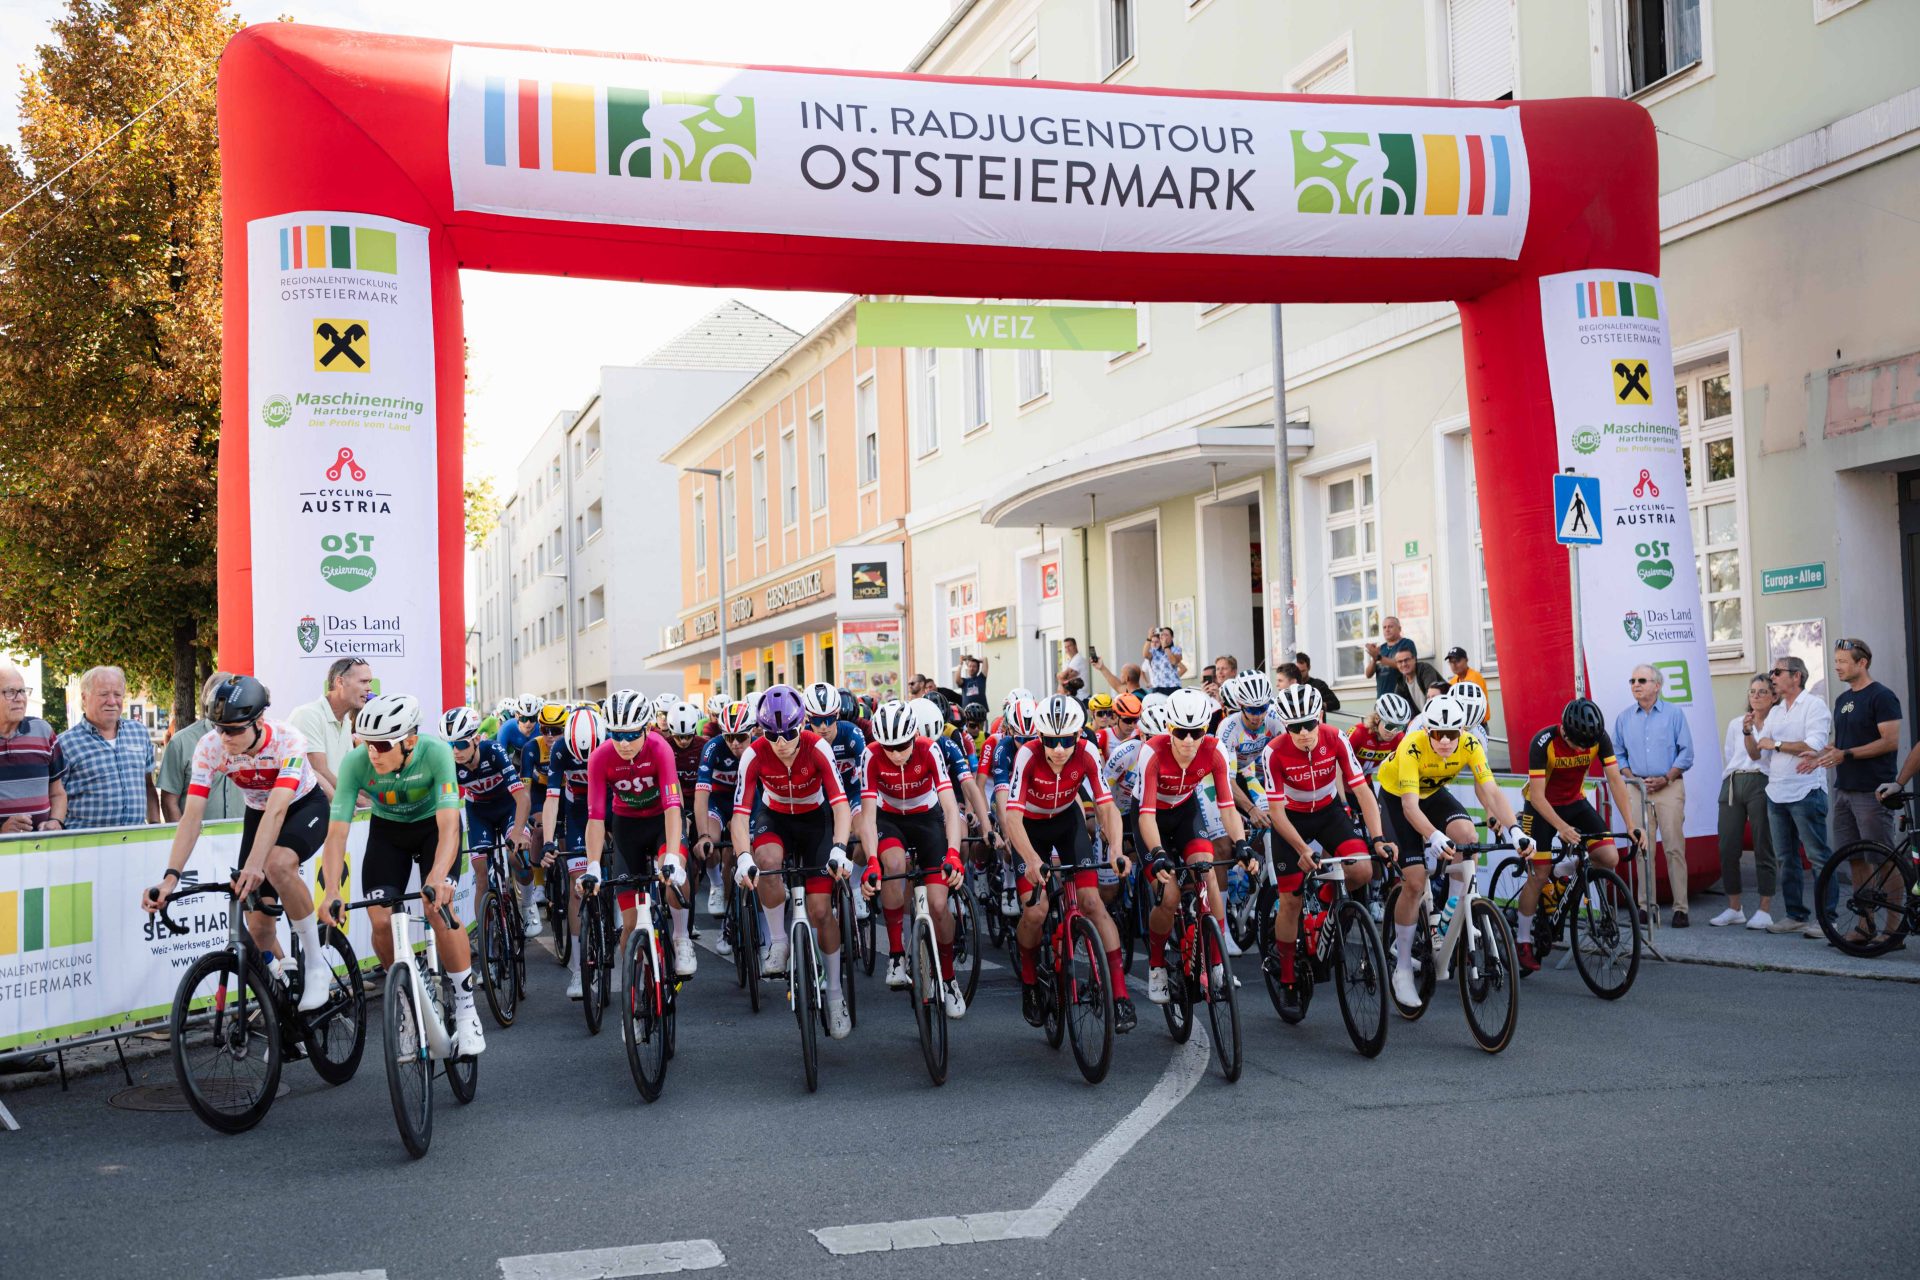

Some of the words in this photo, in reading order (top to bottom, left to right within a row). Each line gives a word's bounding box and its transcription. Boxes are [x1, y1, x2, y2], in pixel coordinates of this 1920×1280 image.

[800, 101, 877, 134] INT.
[890, 107, 1255, 155] RADJUGENDTOUR
[800, 144, 1257, 211] OSTSTEIERMARK
[280, 276, 398, 291] REGIONALENTWICKLUNG
[281, 288, 398, 305] OSTSTEIERMARK
[965, 314, 1036, 339] WEIZ
[1579, 322, 1661, 334] REGIONALENTWICKLUNG
[1580, 333, 1661, 345] OSTSTEIERMARK
[296, 392, 424, 415] Maschinenring
[313, 407, 408, 420] Hartbergerland
[388, 422, 411, 432] Land
[1603, 422, 1679, 439] Maschinenring
[319, 489, 374, 497] CYCLING
[301, 500, 391, 514] AUSTRIA
[1616, 513, 1676, 526] AUSTRIA
[320, 532, 375, 554] OST
[1634, 540, 1670, 559] OST
[322, 564, 375, 579] Steiermark
[766, 569, 822, 611] GESCHENKE
[327, 615, 357, 631] Das
[363, 615, 400, 631] Land
[1648, 609, 1669, 623] Das
[1671, 608, 1692, 622] Land
[1646, 627, 1695, 641] Steiermark
[324, 638, 401, 654] Steiermark
[1113, 743, 1136, 763] KOLOS
[1285, 766, 1336, 783] AUSTRIA
[614, 776, 654, 793] OST
[765, 777, 817, 791] AUSTRIA
[878, 777, 929, 791] AUSTRIA
[1027, 784, 1080, 801] AUSTRI
[176, 896, 206, 906] SEAT
[212, 936, 225, 946] 104
